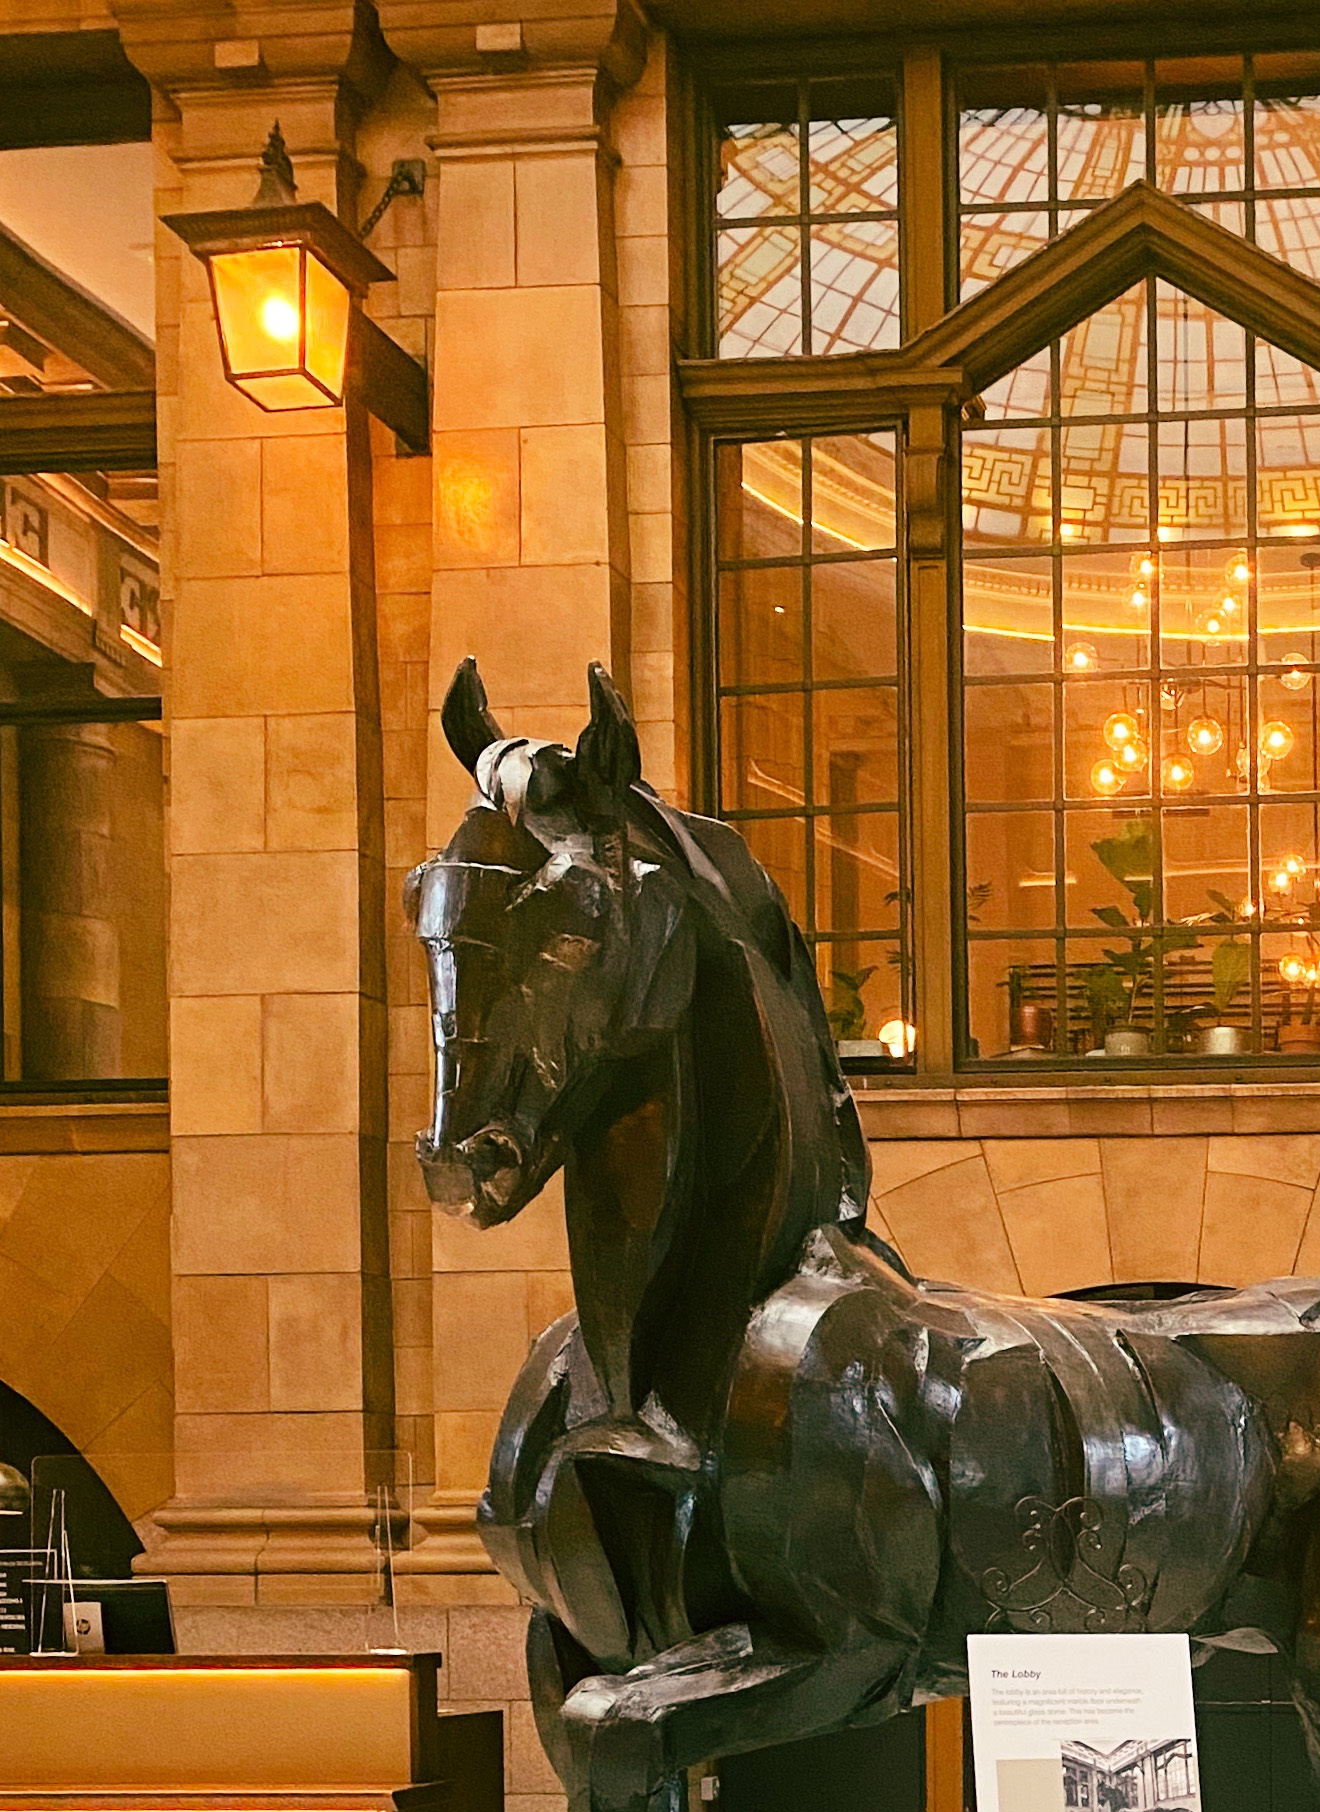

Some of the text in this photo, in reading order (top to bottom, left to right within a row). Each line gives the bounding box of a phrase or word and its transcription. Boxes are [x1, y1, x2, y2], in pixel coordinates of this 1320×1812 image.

[991, 1669, 1042, 1681] The Lobby
[991, 1688, 1005, 1696] The
[1005, 1688, 1023, 1697] lobby
[1098, 1687, 1112, 1695] and
[1028, 1698, 1066, 1707] magnificent
